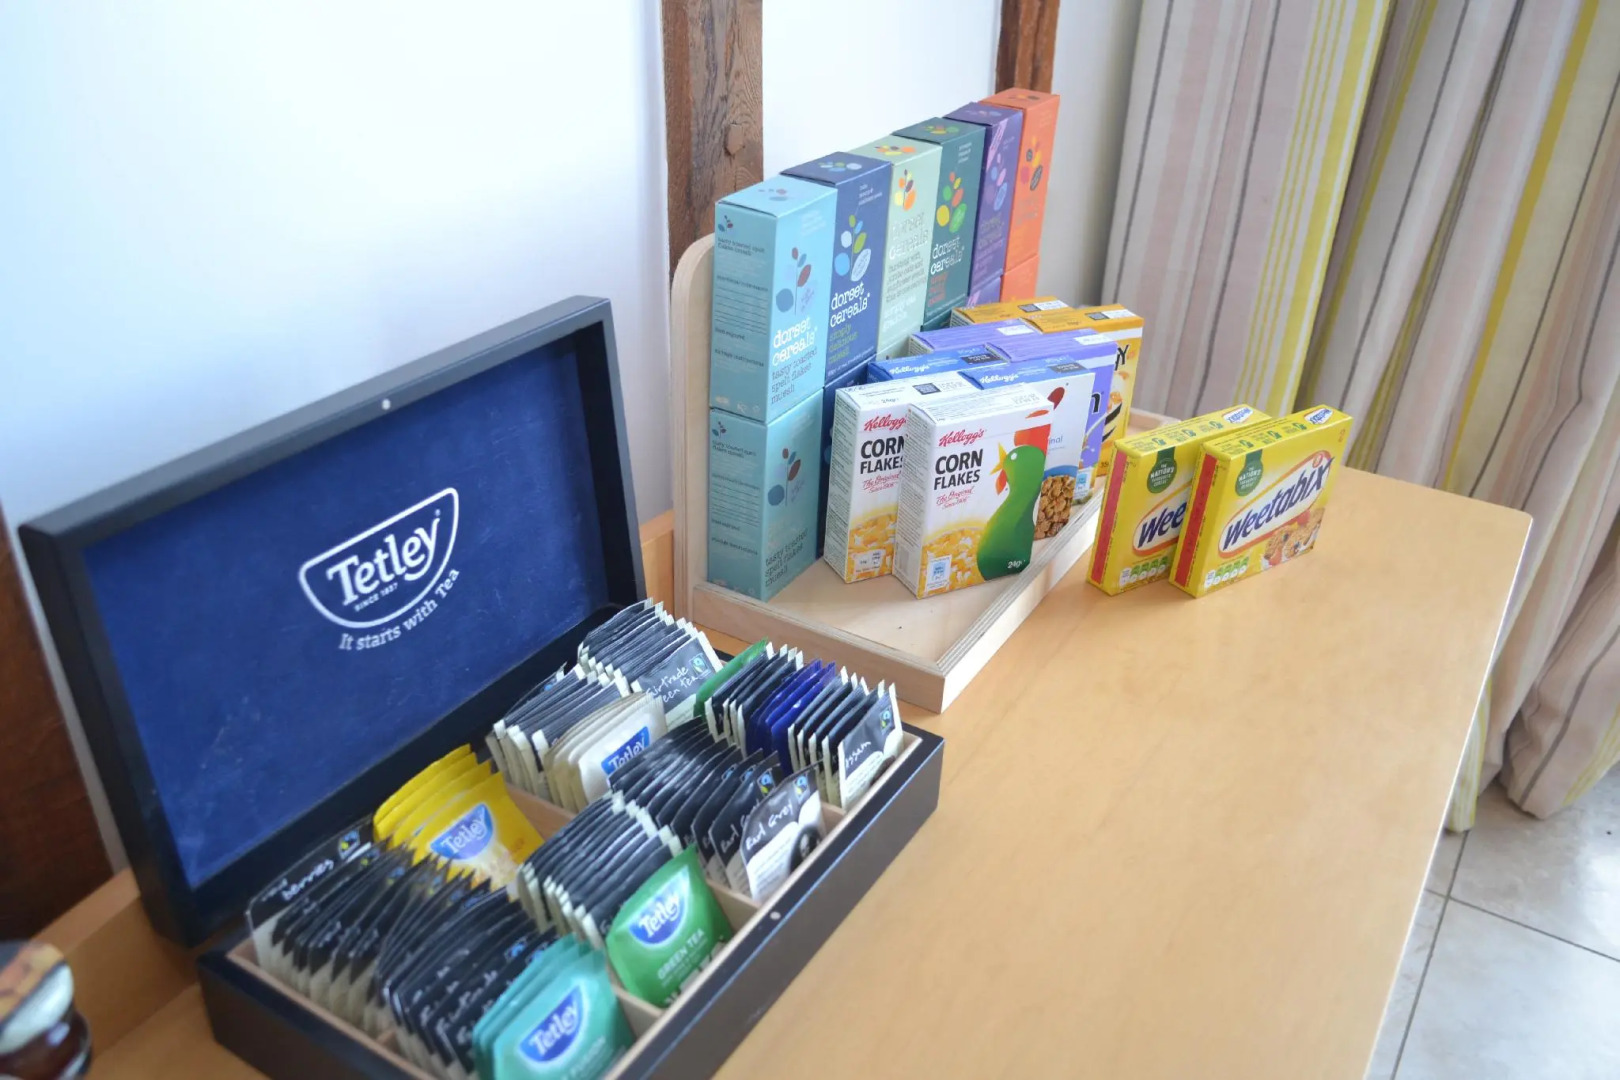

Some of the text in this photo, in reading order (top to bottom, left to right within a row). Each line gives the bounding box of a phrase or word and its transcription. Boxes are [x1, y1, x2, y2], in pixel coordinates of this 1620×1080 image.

[932, 236, 961, 259] dorset
[830, 296, 869, 327] cereals
[831, 281, 864, 310] dorset
[772, 328, 817, 366] cereals
[773, 316, 812, 349] dorset
[938, 428, 985, 447] Kellogg's
[935, 449, 984, 475] CORN
[934, 469, 981, 491] FLAKES
[1222, 457, 1335, 551] Weetabix
[326, 508, 441, 606] Tetley
[338, 568, 460, 651] It starts with Tea
[354, 593, 380, 612] SINCE
[440, 804, 488, 854] Tetley
[745, 821, 766, 851] Earl
[768, 798, 794, 828] Grey
[638, 894, 681, 938] Tetley
[657, 945, 688, 980] GREEN
[686, 927, 705, 949] TEA
